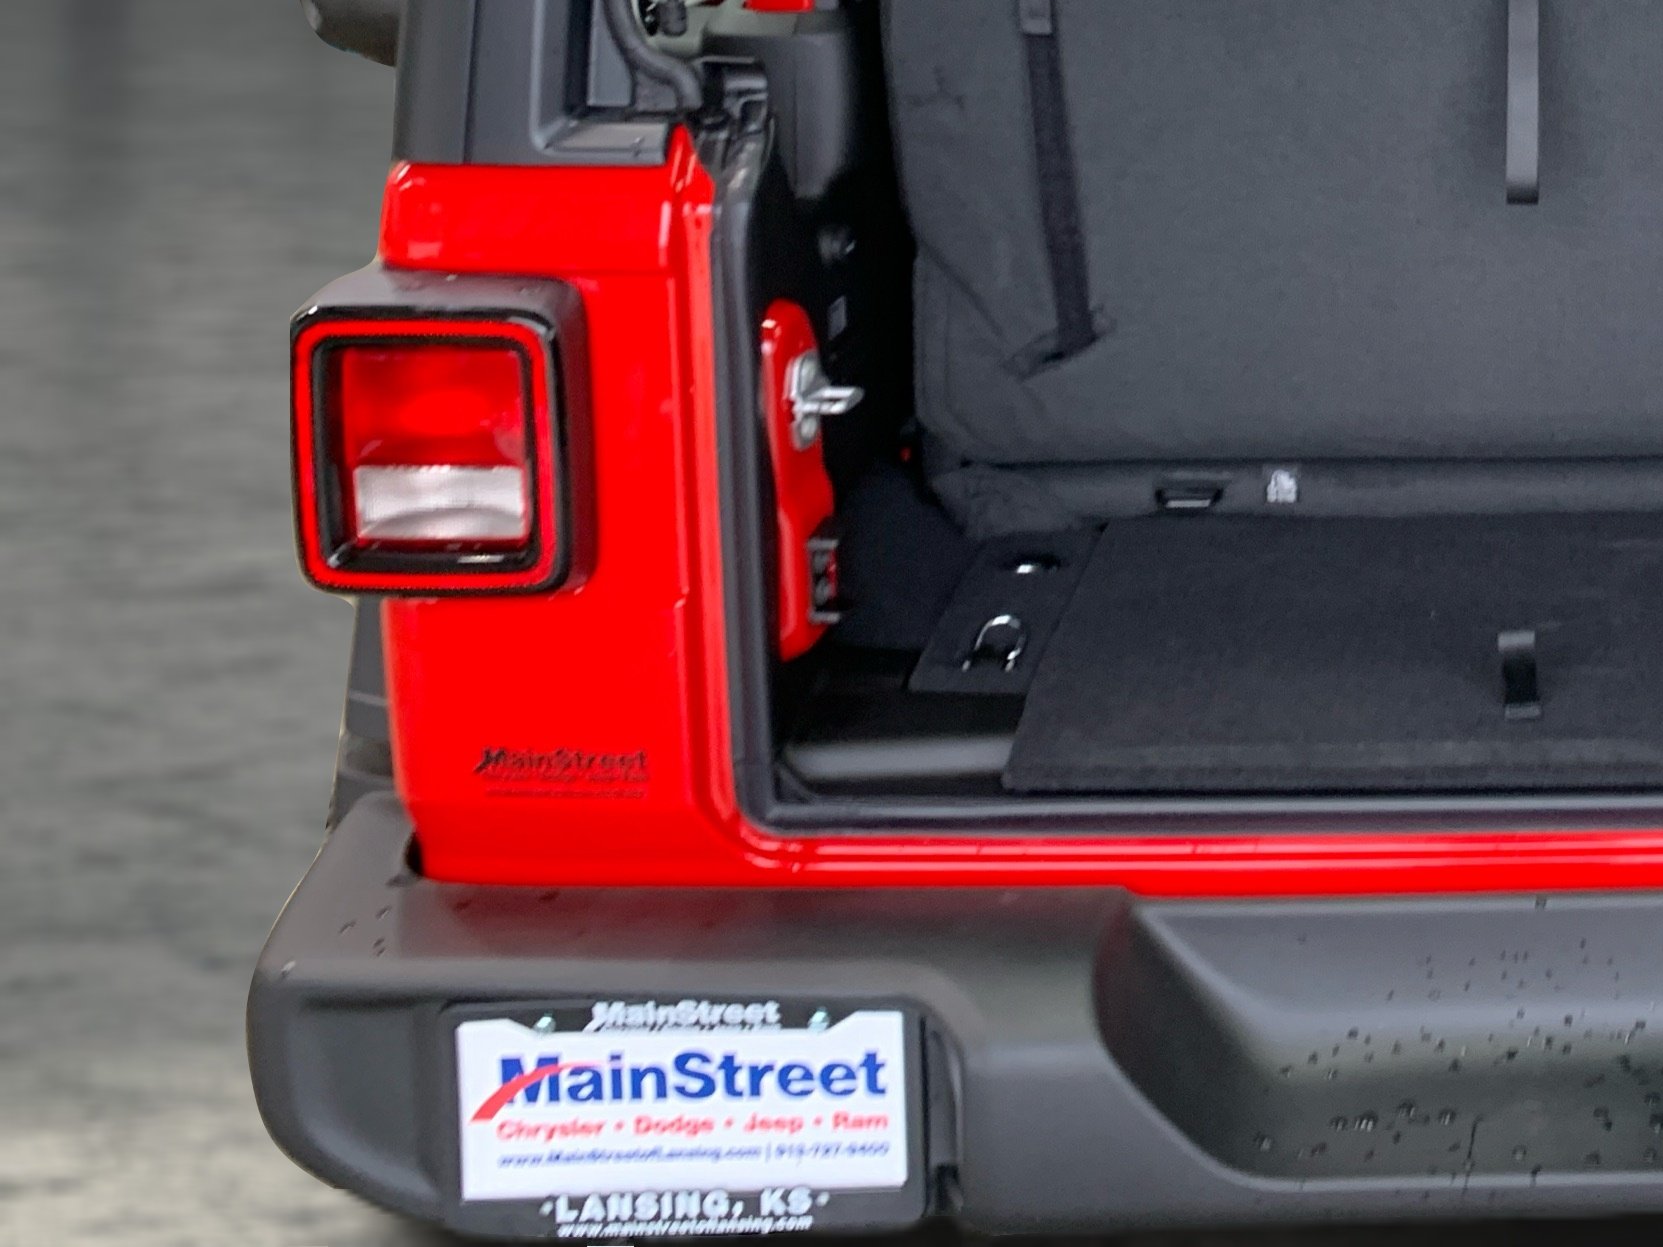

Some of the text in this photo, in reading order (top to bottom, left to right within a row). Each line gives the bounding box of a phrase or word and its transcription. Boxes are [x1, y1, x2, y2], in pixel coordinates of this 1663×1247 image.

[588, 999, 781, 1028] MainStreet
[498, 1051, 888, 1105] MainStreet
[497, 1110, 890, 1142] Chrysler Dodge Jeep Ram
[556, 1187, 813, 1223] LANSING, KS
